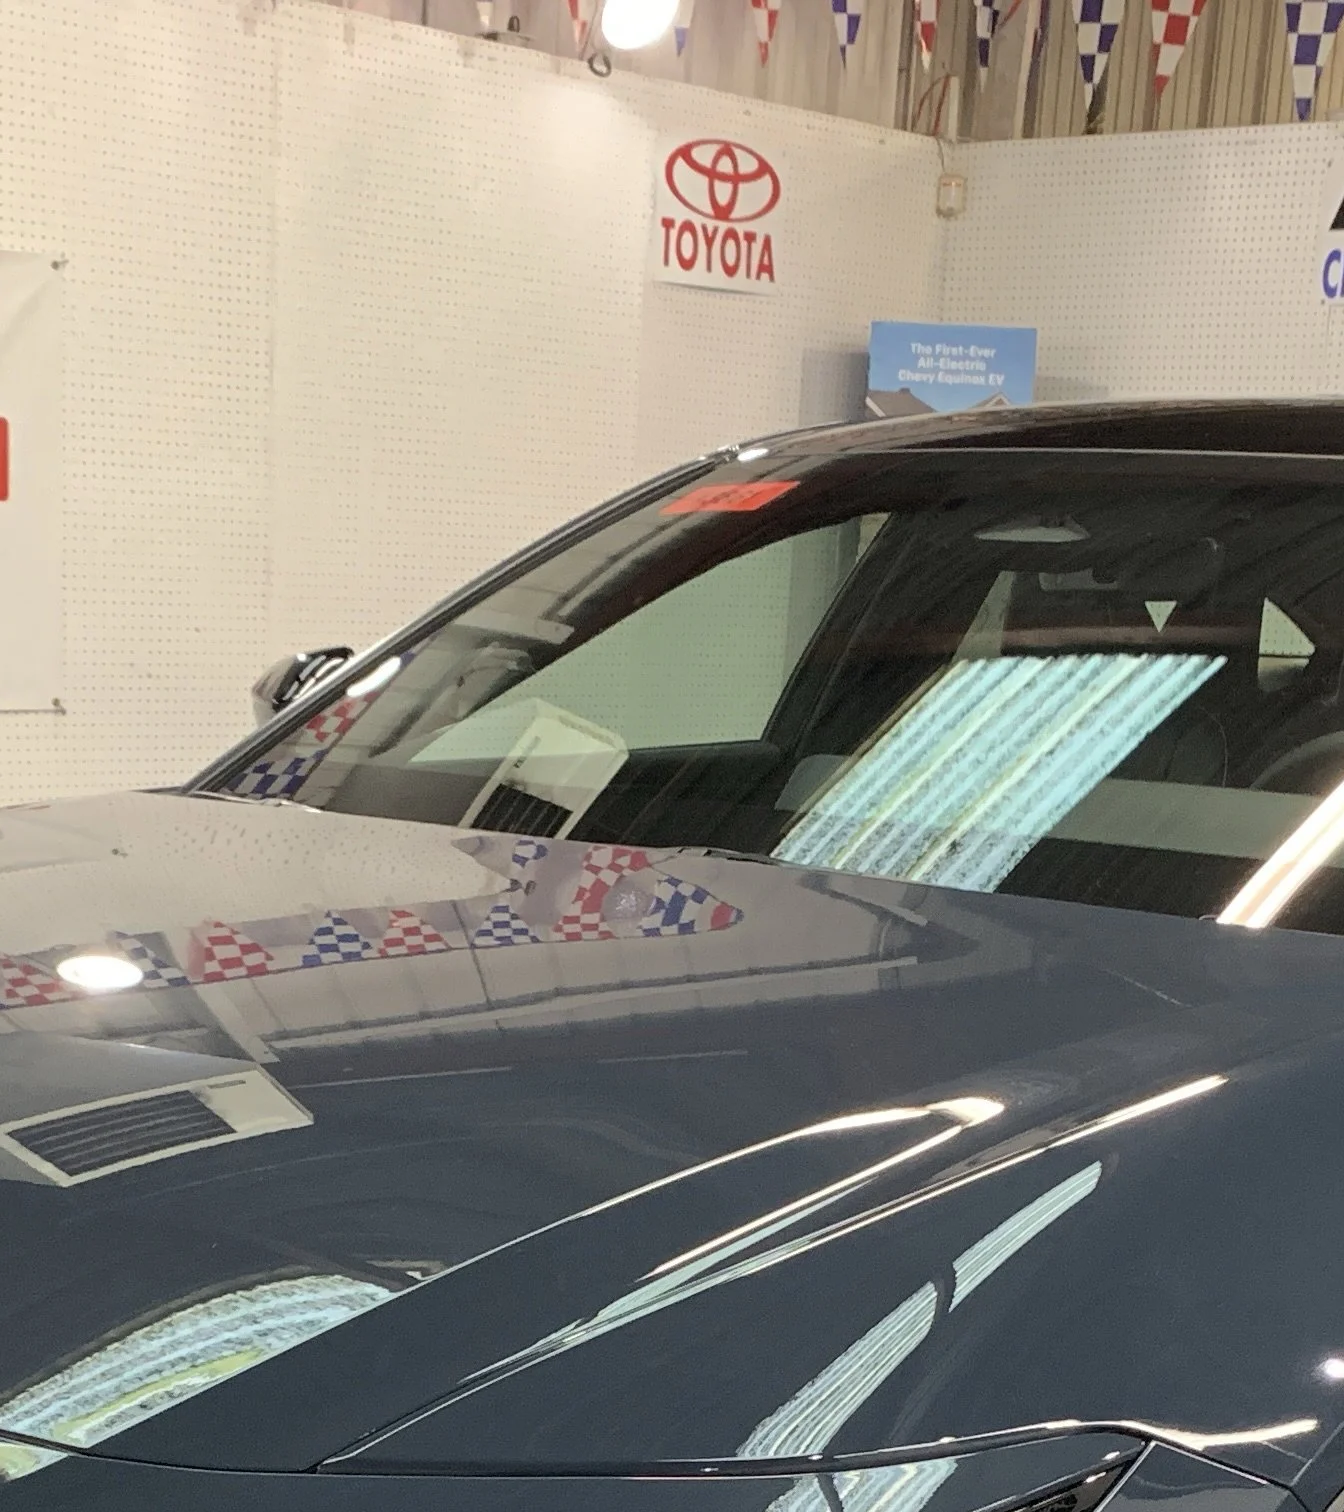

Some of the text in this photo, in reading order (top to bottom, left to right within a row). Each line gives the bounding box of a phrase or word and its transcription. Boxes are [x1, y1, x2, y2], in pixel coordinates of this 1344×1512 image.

[660, 216, 775, 282] TOYOTA
[911, 342, 933, 355] The
[898, 370, 1005, 386] Chevy Equinox EV
